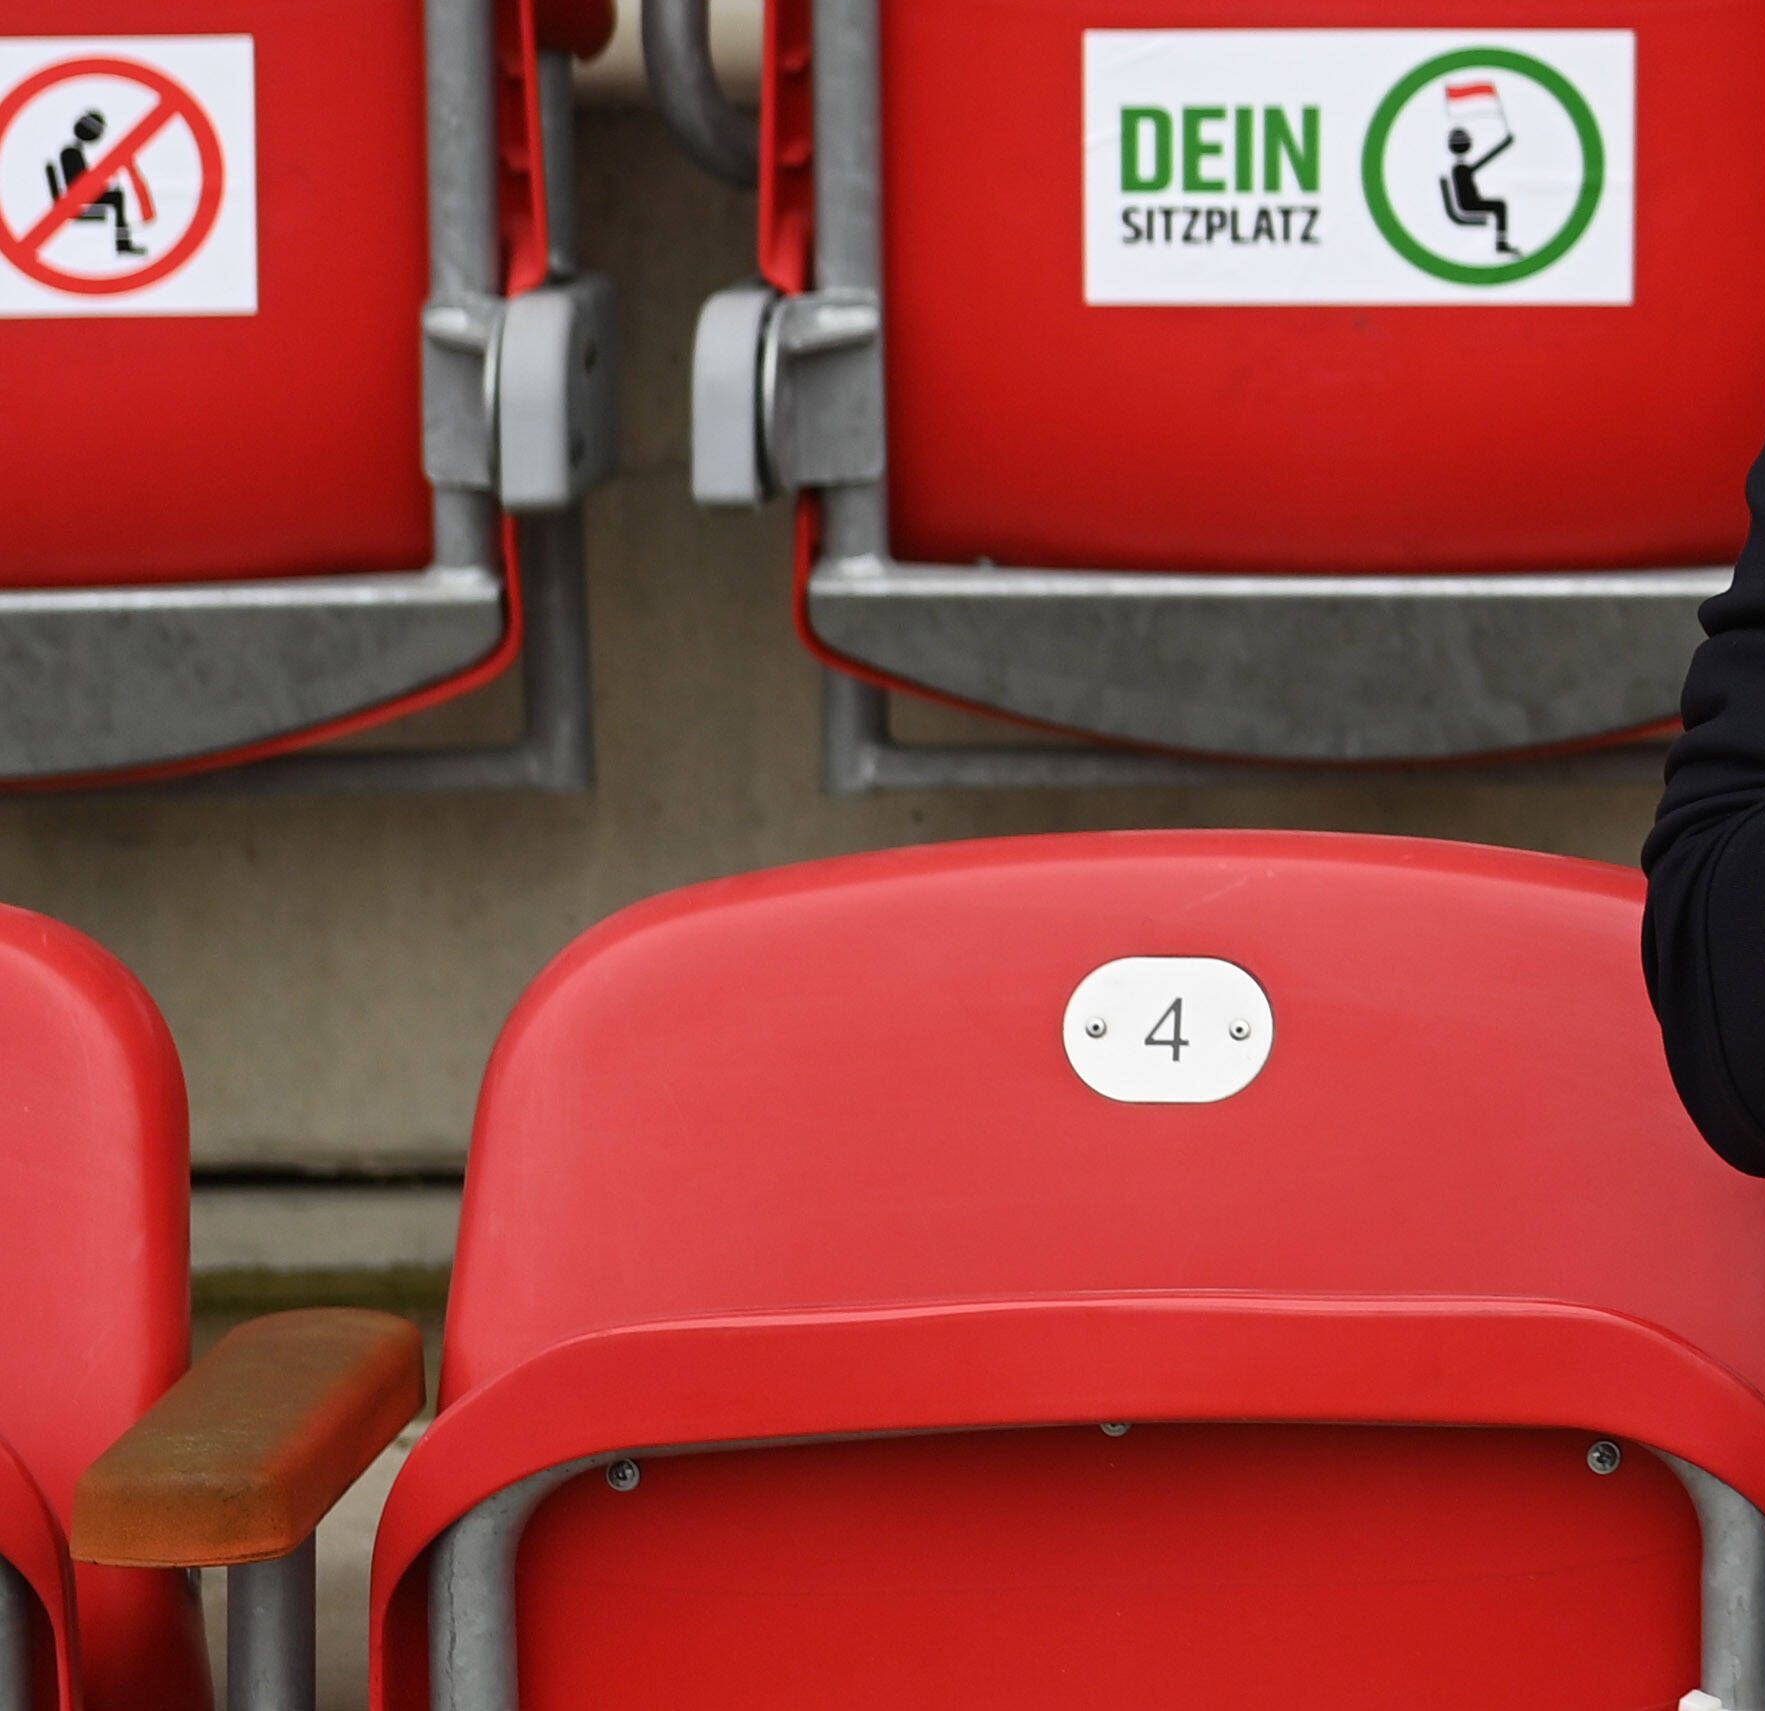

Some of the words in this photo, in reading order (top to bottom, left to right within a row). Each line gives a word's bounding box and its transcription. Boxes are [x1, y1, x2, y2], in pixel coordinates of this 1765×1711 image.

[1119, 104, 1321, 194] DEIN
[1120, 206, 1321, 244] SITZPLATZ
[1144, 997, 1189, 1062] 4
